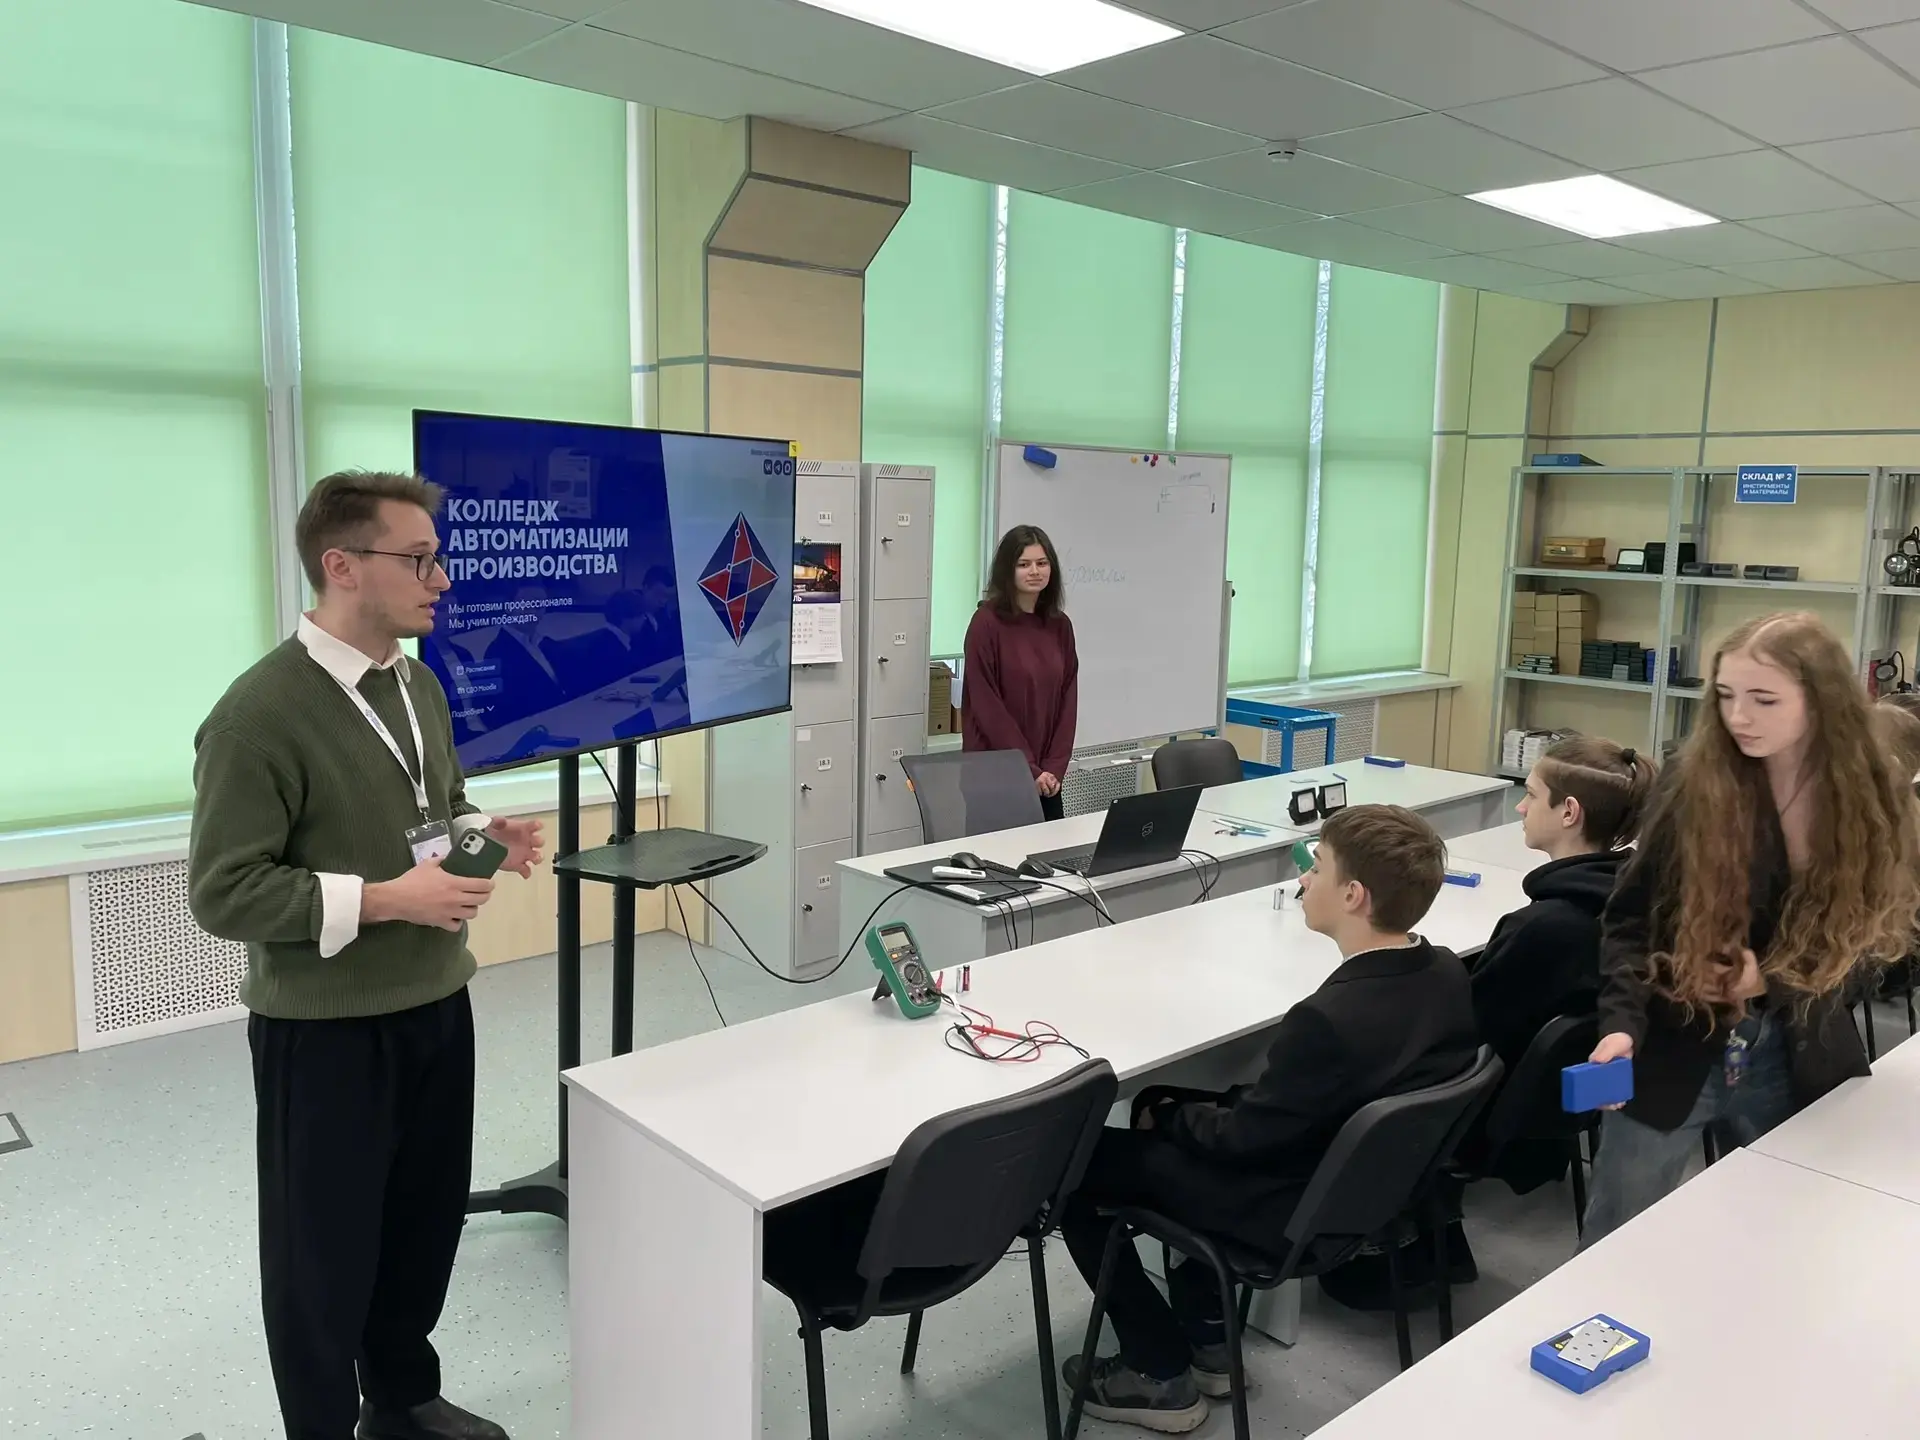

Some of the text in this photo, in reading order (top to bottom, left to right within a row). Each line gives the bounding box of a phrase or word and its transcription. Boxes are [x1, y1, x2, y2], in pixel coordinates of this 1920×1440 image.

[1741, 473, 1774, 481] СКЛАД
[1786, 473, 1793, 481] 2
[448, 499, 560, 525] КОЛЛЕДЖ
[448, 527, 628, 551] АВТОМАТИЗАЦИИ
[449, 553, 618, 581] ПРОИЗВОДСТВА
[448, 597, 573, 614] Мы готовим профессионалов
[448, 614, 538, 630] Мы учим побеждать
